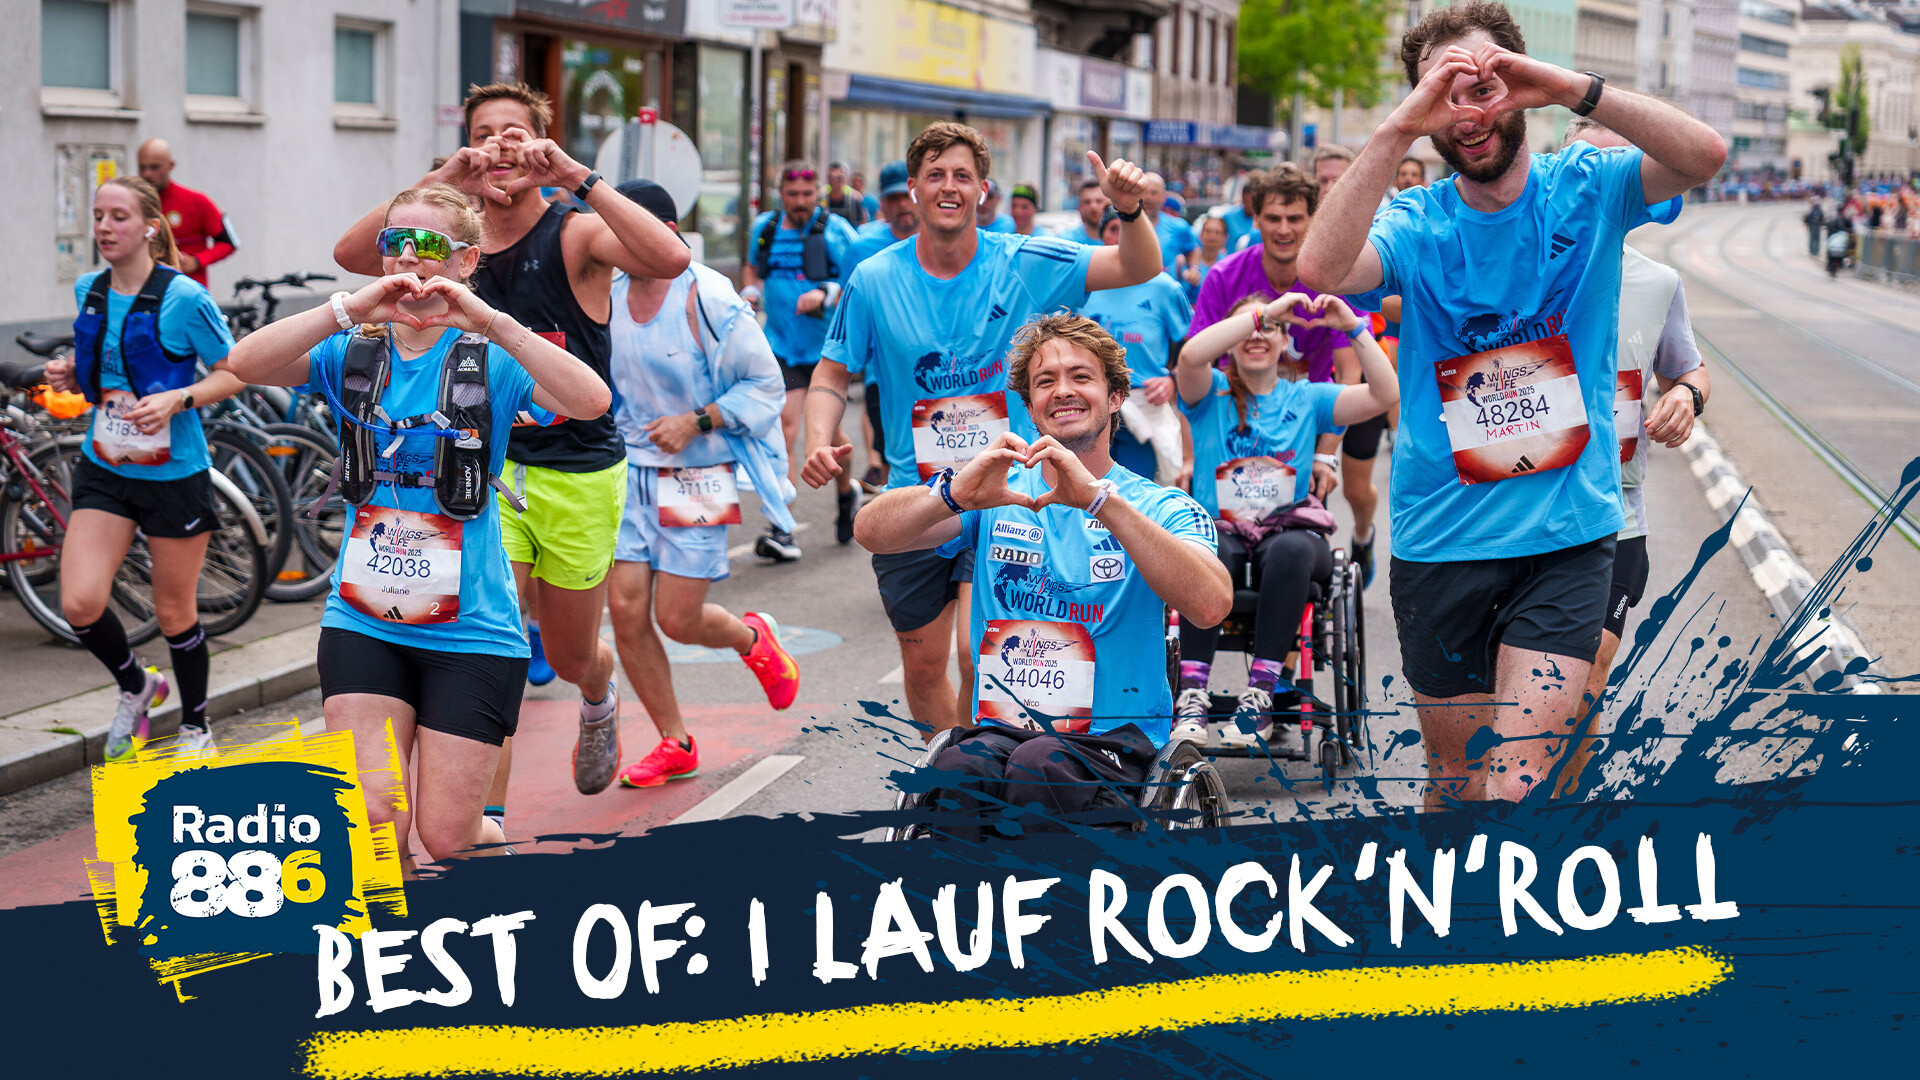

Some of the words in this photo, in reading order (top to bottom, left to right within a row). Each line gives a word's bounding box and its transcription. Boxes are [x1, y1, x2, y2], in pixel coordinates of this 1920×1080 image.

[1487, 367, 1527, 383] WINGS
[1495, 378, 1517, 392] LIFE
[1519, 386, 1535, 397] 2025
[1476, 394, 1550, 428] 48284
[106, 420, 146, 437] 4183
[1486, 420, 1540, 441] MARTIN
[936, 430, 988, 449] 46273
[464, 465, 472, 500] AONIJIE
[677, 480, 721, 495] 47115
[1234, 484, 1279, 498] 42365
[994, 523, 1027, 537] Allianz
[407, 548, 422, 557] 2025
[993, 546, 1041, 565] RADO
[367, 554, 431, 578] 42038
[381, 585, 410, 596] Juliane
[1029, 575, 1066, 592] WINGS
[1031, 584, 1053, 598] LIFE
[429, 601, 440, 616] 2
[1613, 594, 1628, 619] FUSION
[1022, 638, 1058, 650] WINGS
[1026, 649, 1047, 658] LIFE
[1044, 659, 1058, 668] 2025
[1003, 667, 1065, 690] 44046
[1023, 698, 1040, 707] Nico
